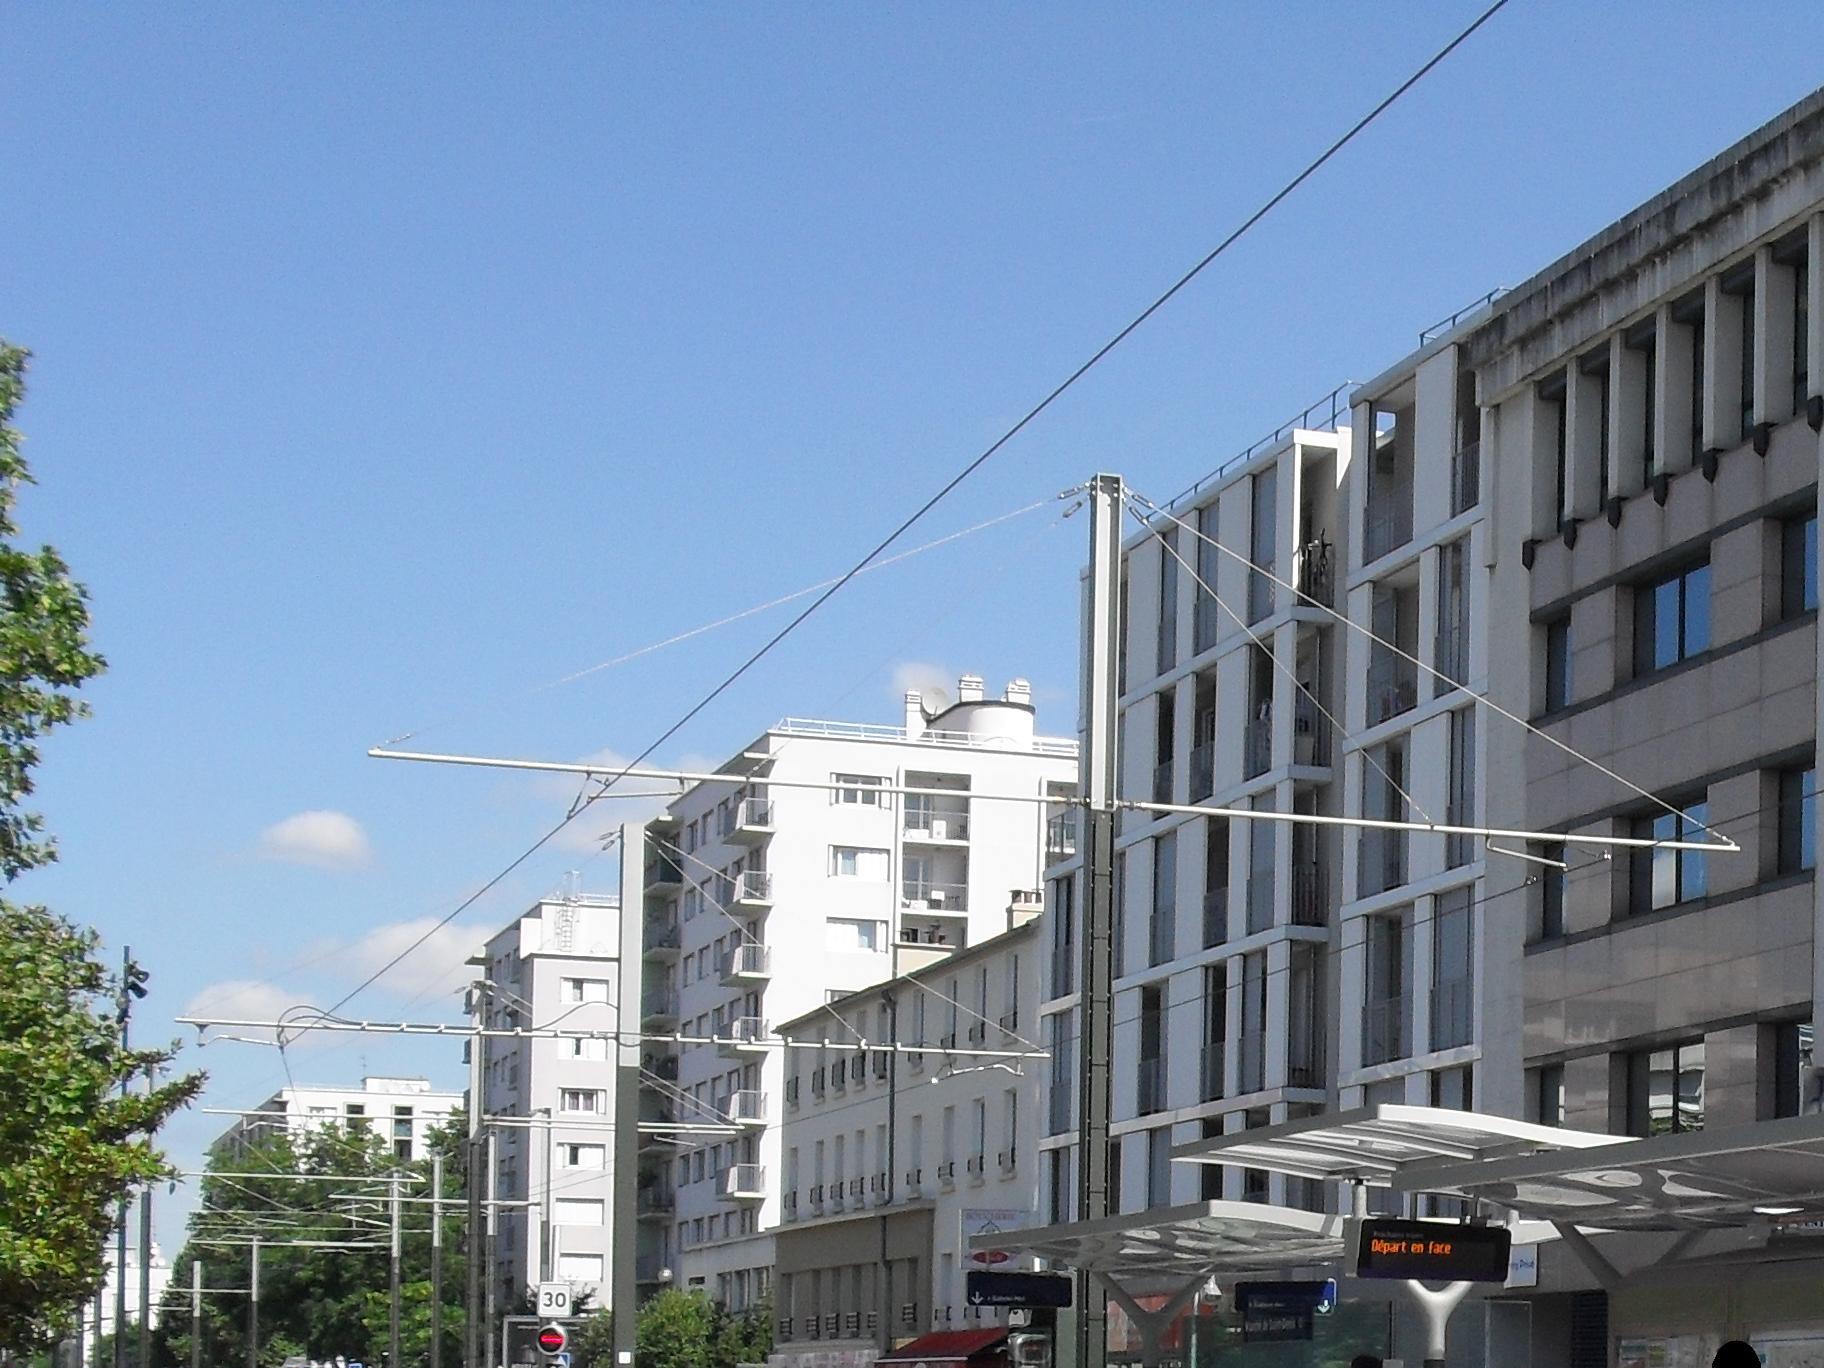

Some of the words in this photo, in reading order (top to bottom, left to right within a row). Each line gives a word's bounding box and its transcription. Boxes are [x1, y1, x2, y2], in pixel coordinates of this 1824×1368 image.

[1371, 1239, 1406, 1254] Départ
[1411, 1242, 1424, 1253] en
[1428, 1241, 1452, 1254] face
[543, 1292, 566, 1307] 30
